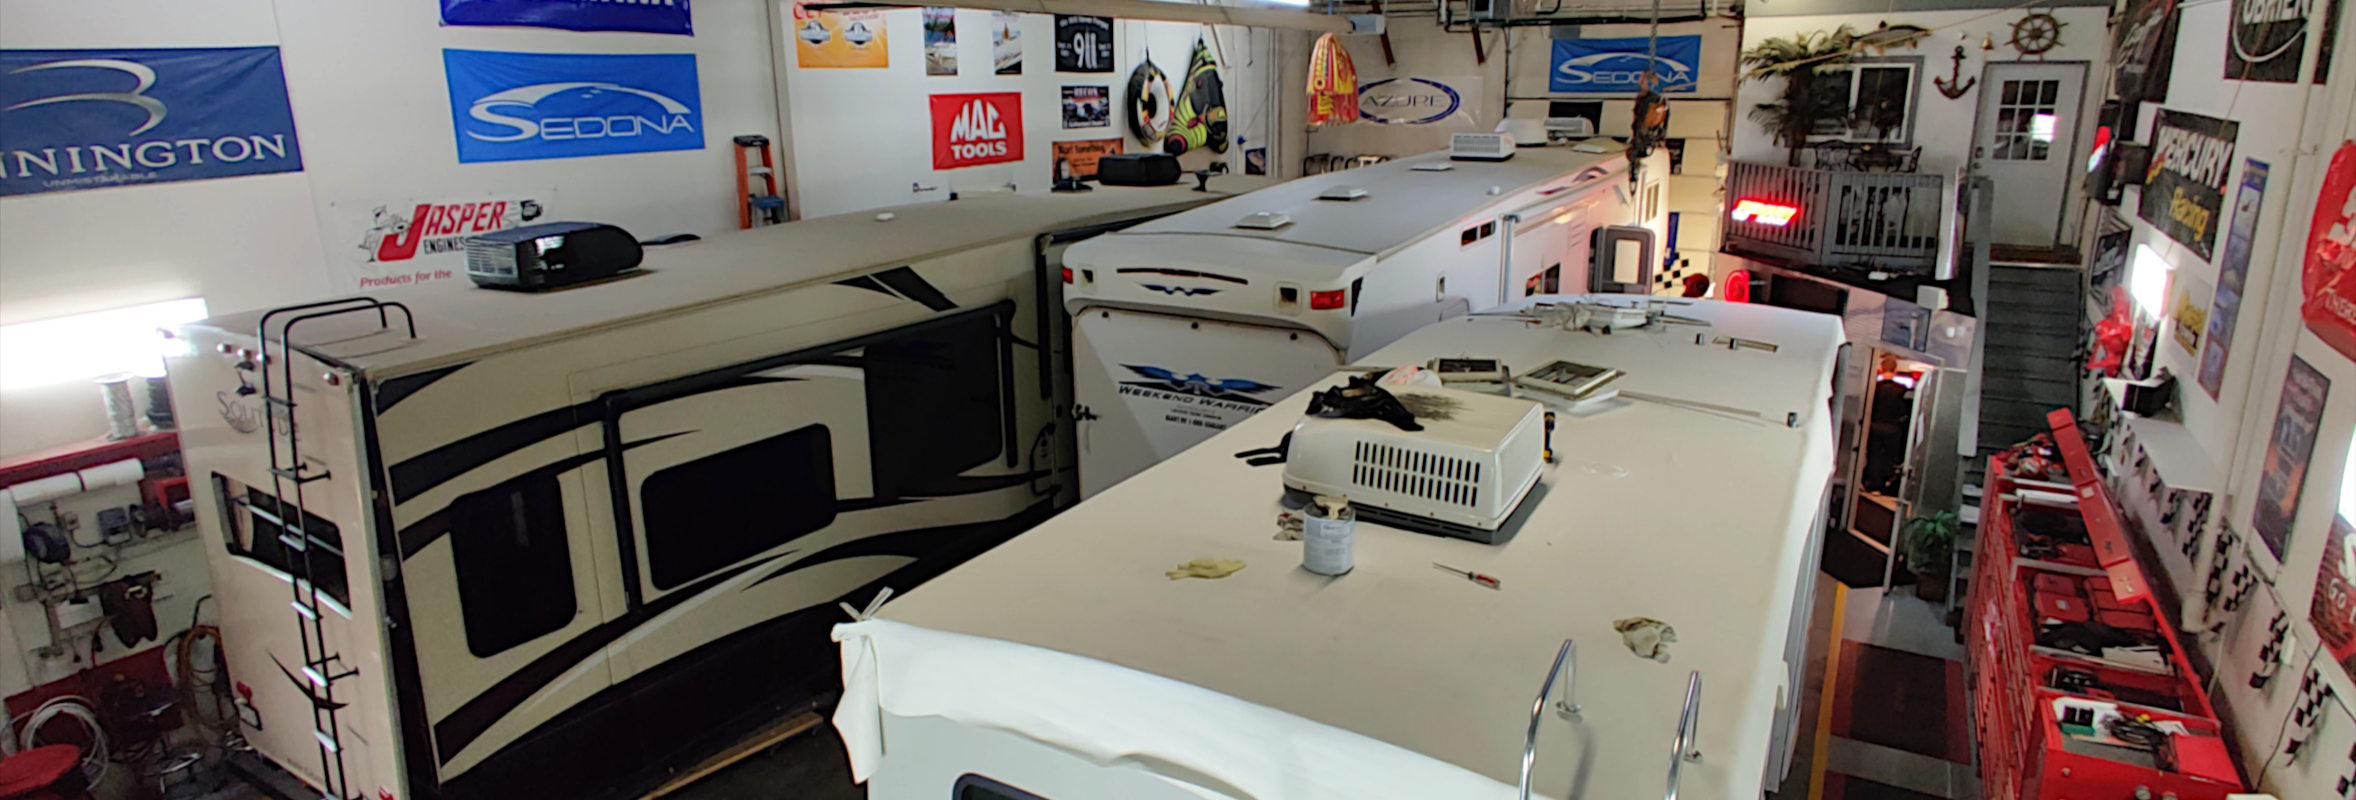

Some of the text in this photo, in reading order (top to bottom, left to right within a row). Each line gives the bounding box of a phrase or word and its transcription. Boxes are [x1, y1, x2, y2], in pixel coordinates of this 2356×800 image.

[1073, 32, 1099, 69] 911
[950, 98, 1007, 143] MAC
[1361, 94, 1446, 108] AZURE
[467, 100, 695, 143] SEDONA
[0, 134, 286, 180] NINGTON
[950, 140, 1008, 160] TOOLS
[377, 201, 508, 262] JASPER
[2169, 186, 2210, 241] Racing
[360, 269, 452, 288] Products for the
[1118, 385, 1195, 404] WEEKEND
